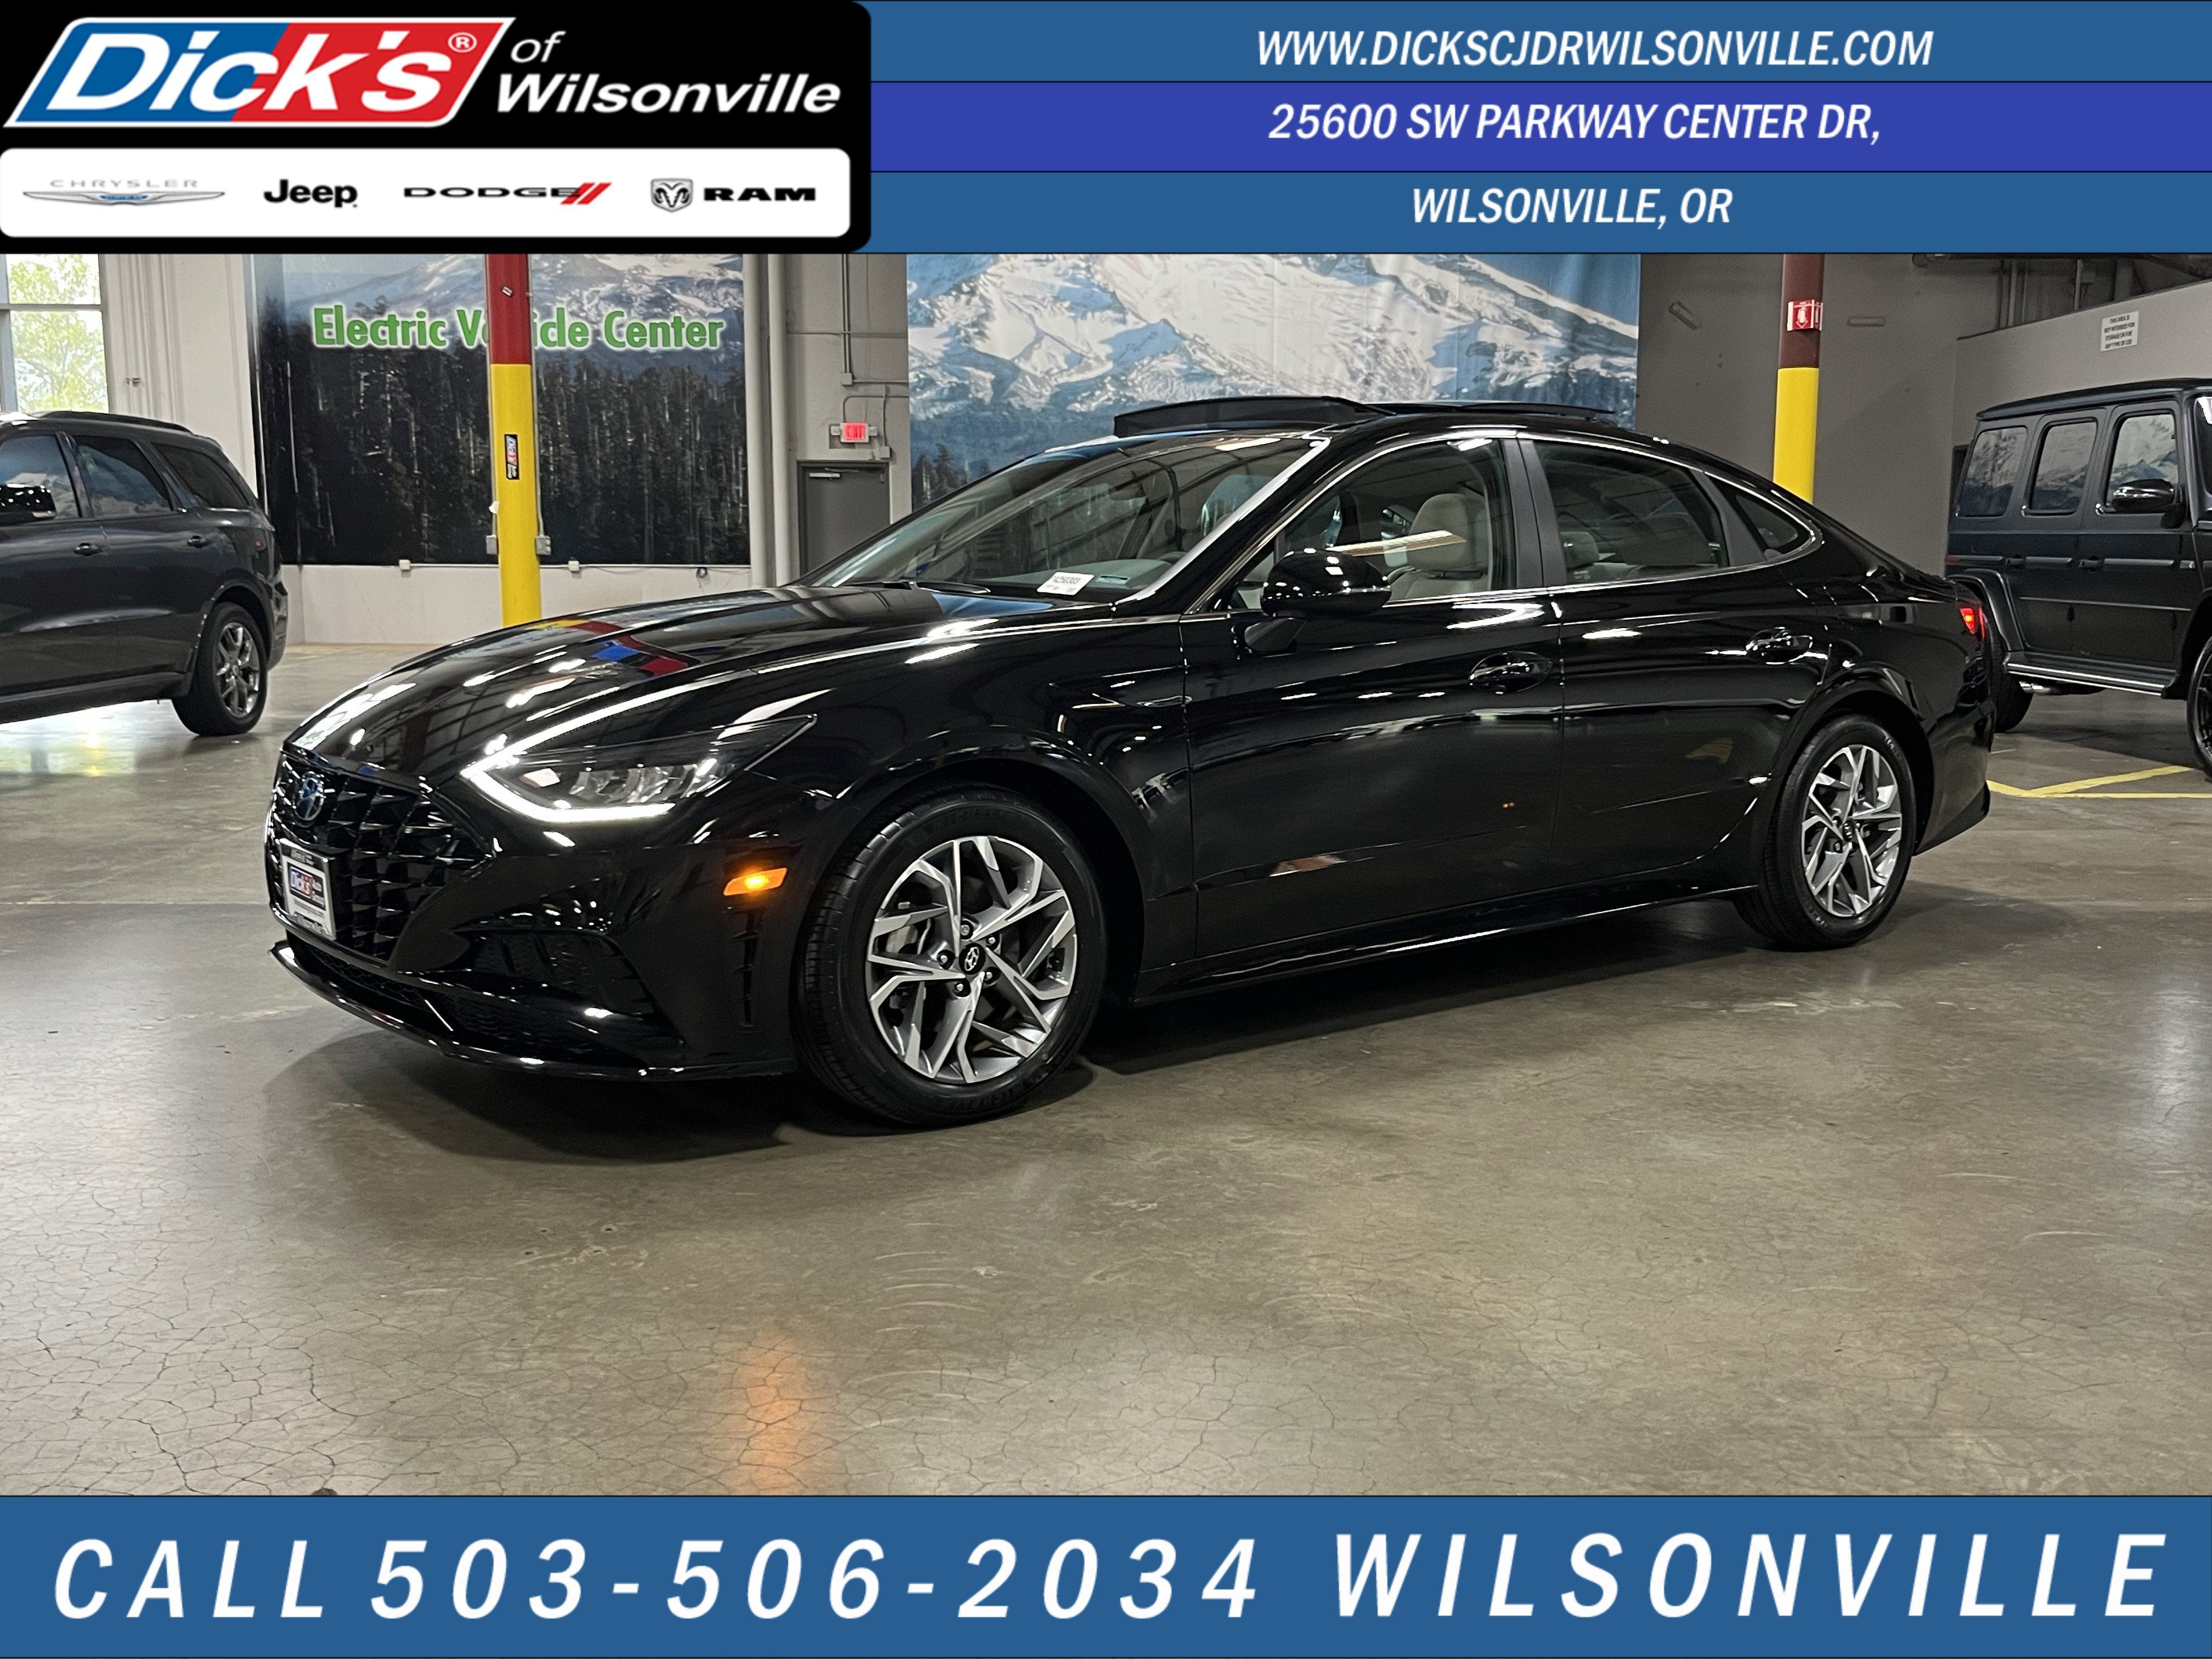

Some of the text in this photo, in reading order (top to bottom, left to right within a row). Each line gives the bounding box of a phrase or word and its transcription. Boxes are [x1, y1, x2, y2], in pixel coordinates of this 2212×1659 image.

[313, 306, 723, 348] Electric Vicle Center
